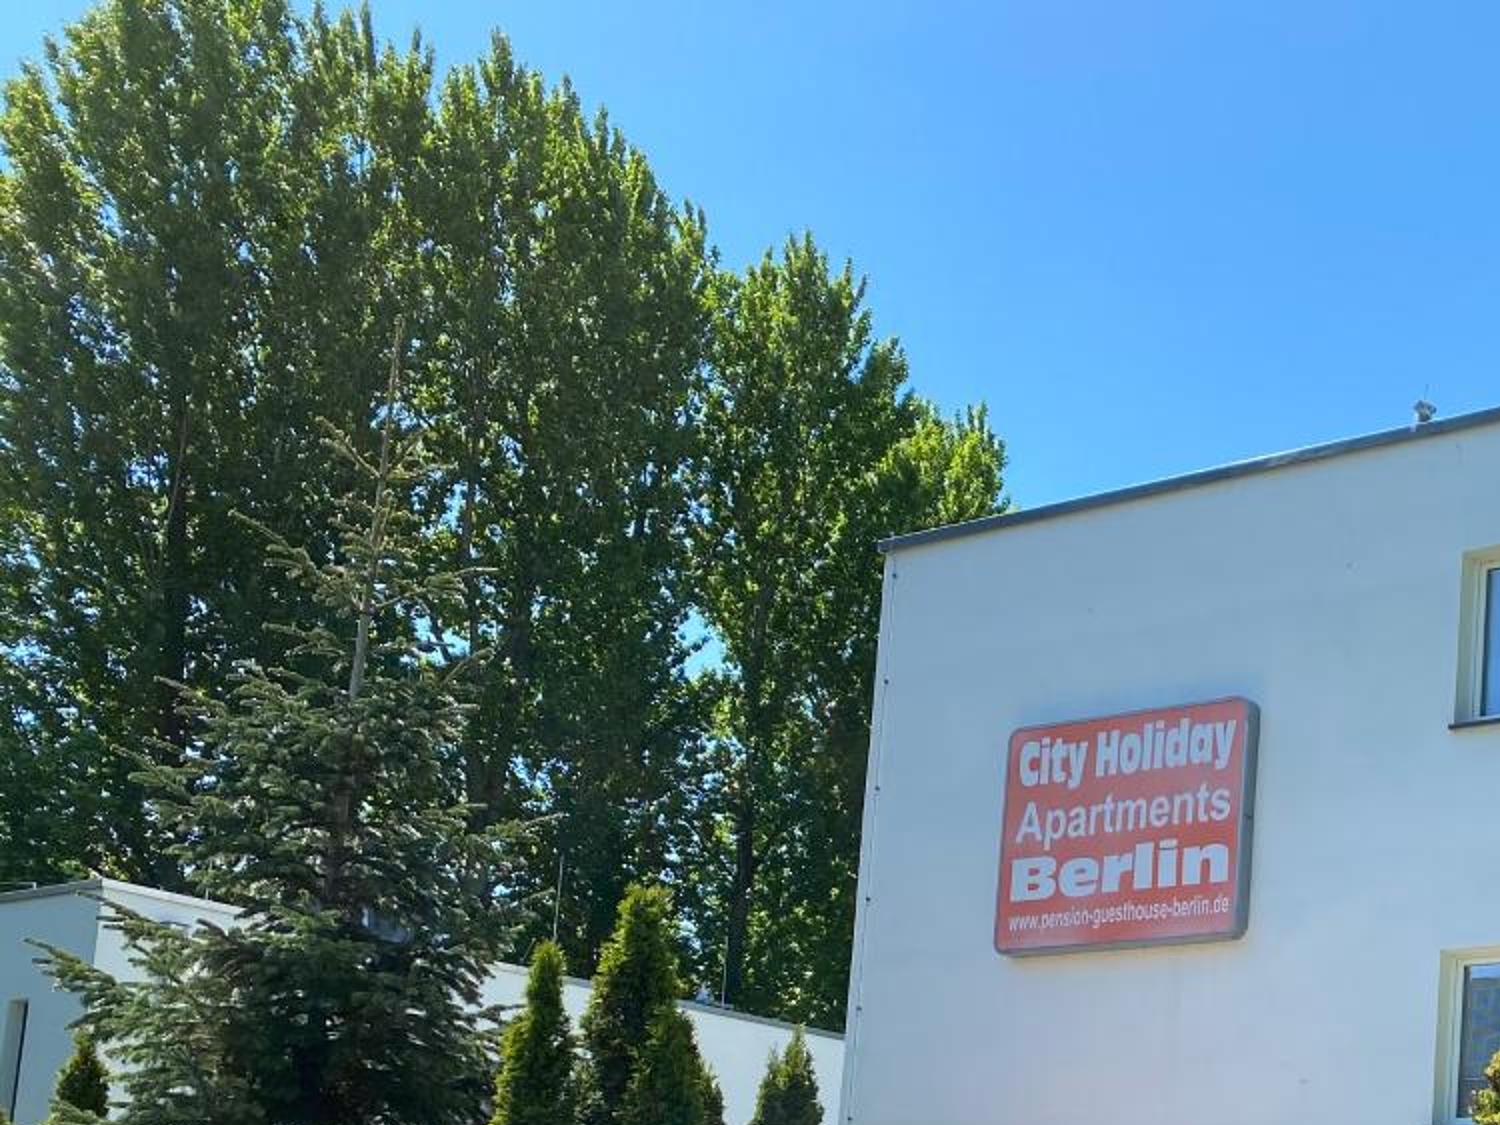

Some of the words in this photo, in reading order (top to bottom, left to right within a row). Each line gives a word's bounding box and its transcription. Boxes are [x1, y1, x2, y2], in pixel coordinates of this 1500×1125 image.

[1019, 736, 1089, 790] City
[1095, 717, 1237, 777] Holiday
[1015, 783, 1232, 851] Apartments
[1010, 838, 1229, 903] Berlin
[1008, 893, 1229, 932] www.pension-guesthouse-berlin.de
